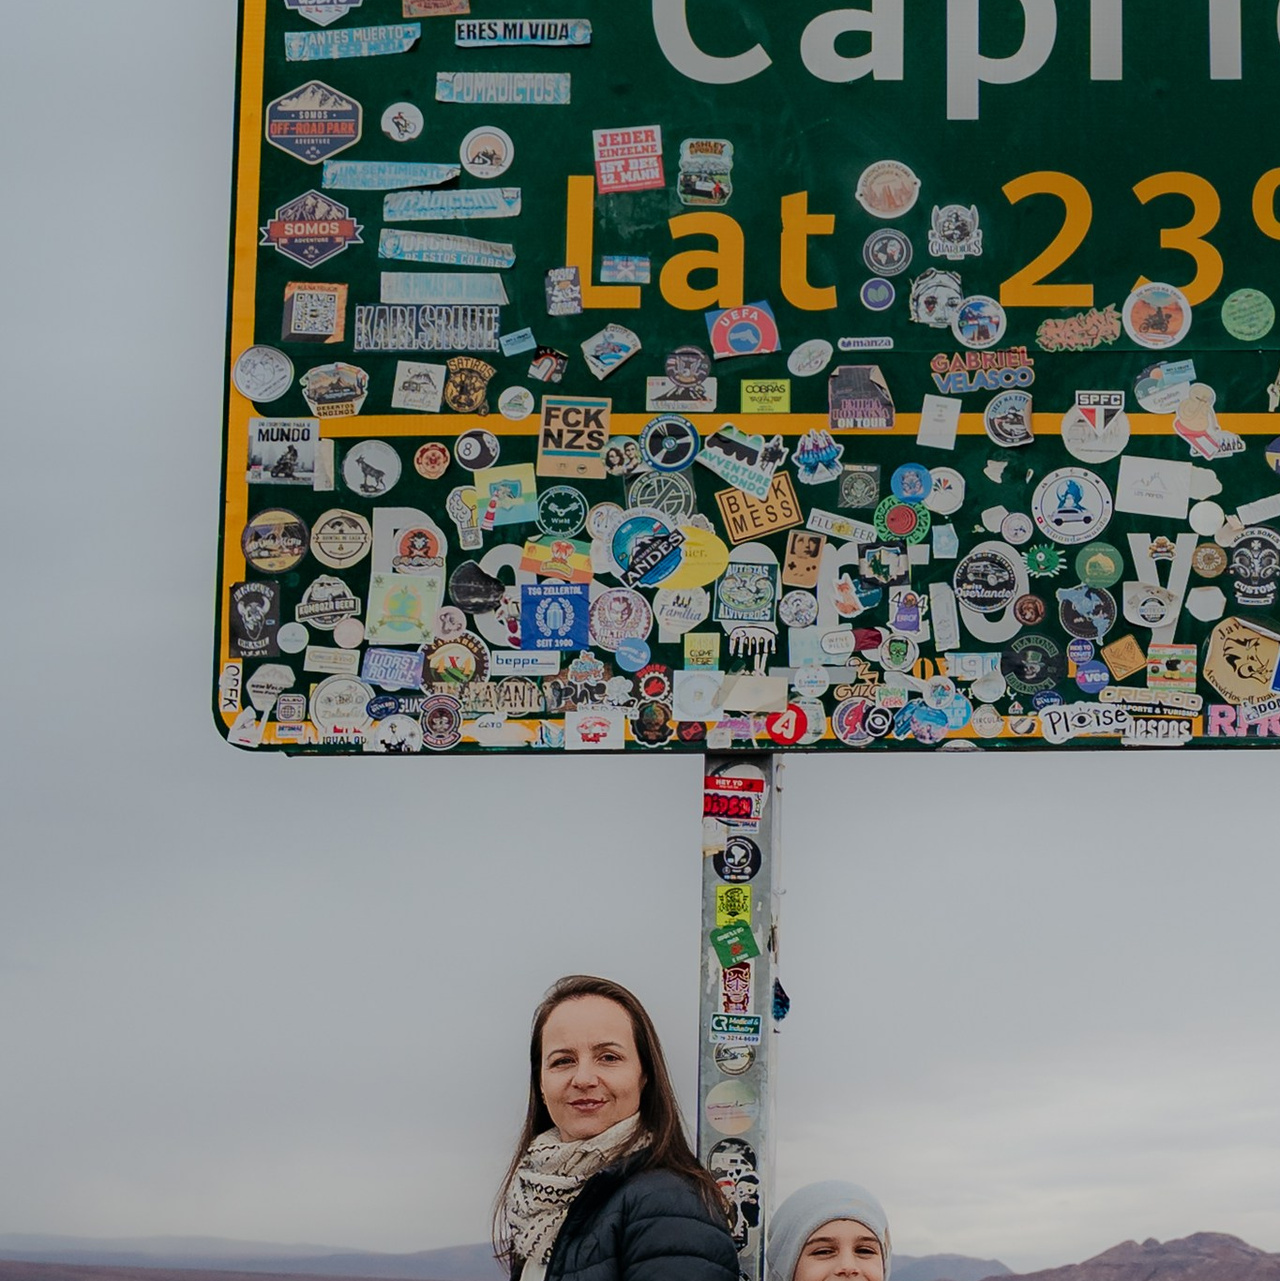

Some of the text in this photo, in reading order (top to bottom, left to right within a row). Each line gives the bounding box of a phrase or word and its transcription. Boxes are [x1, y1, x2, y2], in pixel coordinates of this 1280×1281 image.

[308, 27, 404, 48] ANTES MUERTO
[457, 22, 570, 41] ERES MI VIDA
[299, 110, 330, 121] SOMOS
[270, 122, 355, 136] OFF-ROAD PARK
[598, 129, 656, 148] JEDER
[599, 144, 658, 158] EINZELNE
[600, 157, 659, 174] IST DER
[601, 167, 660, 185] 12. MANN
[284, 222, 340, 236] SOMOS
[565, 175, 838, 311] Lat
[404, 253, 510, 269] DE ESTOS COLORES
[719, 308, 760, 328] UEFA
[354, 305, 500, 352] KARLSRUHE
[853, 338, 892, 348] manza
[931, 347, 1034, 373] GABRIEL
[448, 357, 497, 382] SATIROS
[932, 367, 1035, 393] VELASCO
[745, 384, 787, 395] COBRAS
[1078, 394, 1123, 406] SPFC
[543, 406, 606, 429] FCK
[838, 417, 887, 428] ON TOUR
[257, 427, 311, 442] MUNDO
[542, 428, 606, 450] NZS
[699, 448, 772, 489] AVVENTURE
[720, 468, 768, 498] MONDO
[733, 500, 795, 536] MESS
[626, 529, 686, 587] ANDES
[726, 563, 769, 578] AUTISTAS
[527, 586, 540, 596] TSG
[1234, 581, 1278, 596] CUSTOM
[334, 598, 355, 611] BEER
[717, 607, 772, 621] ALVIVERDES
[536, 638, 551, 648] SEIT
[368, 650, 420, 670] WORST
[495, 654, 539, 668] beppe
[368, 664, 416, 684] ADVICE
[1163, 708, 1200, 718] TURISMO
